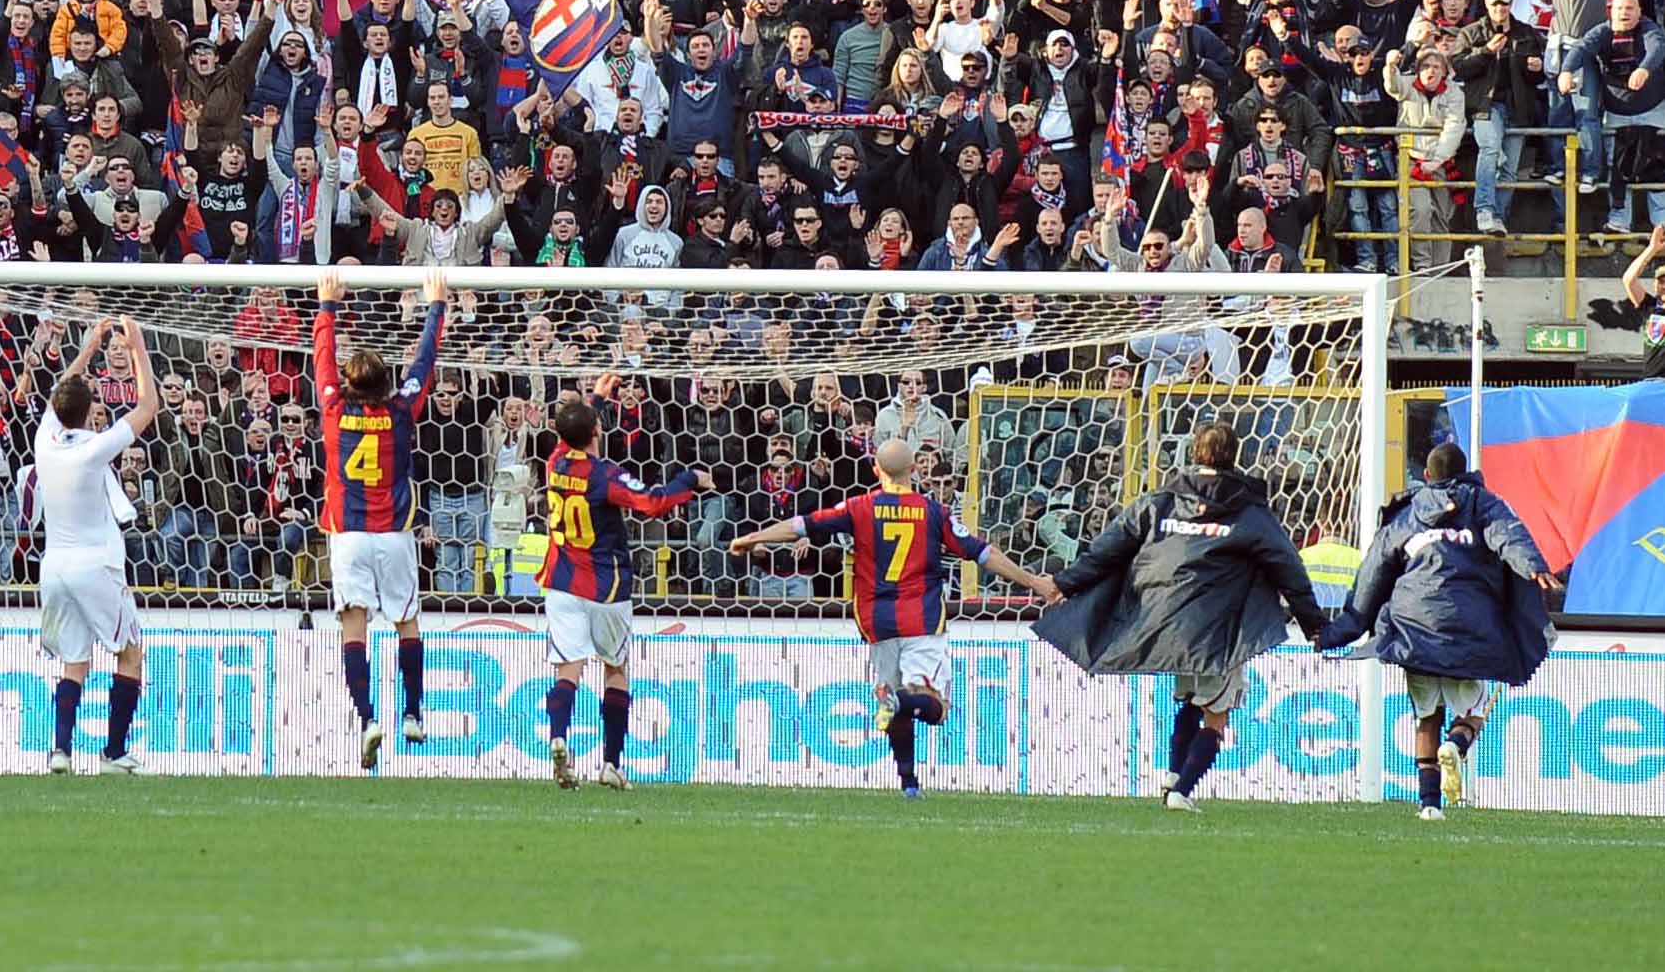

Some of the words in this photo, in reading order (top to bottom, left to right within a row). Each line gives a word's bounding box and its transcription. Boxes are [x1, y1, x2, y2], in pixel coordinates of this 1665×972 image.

[757, 111, 907, 131] BOLOGNA
[344, 433, 384, 488] 4
[874, 505, 925, 520] VALIANI
[881, 521, 916, 584] 7
